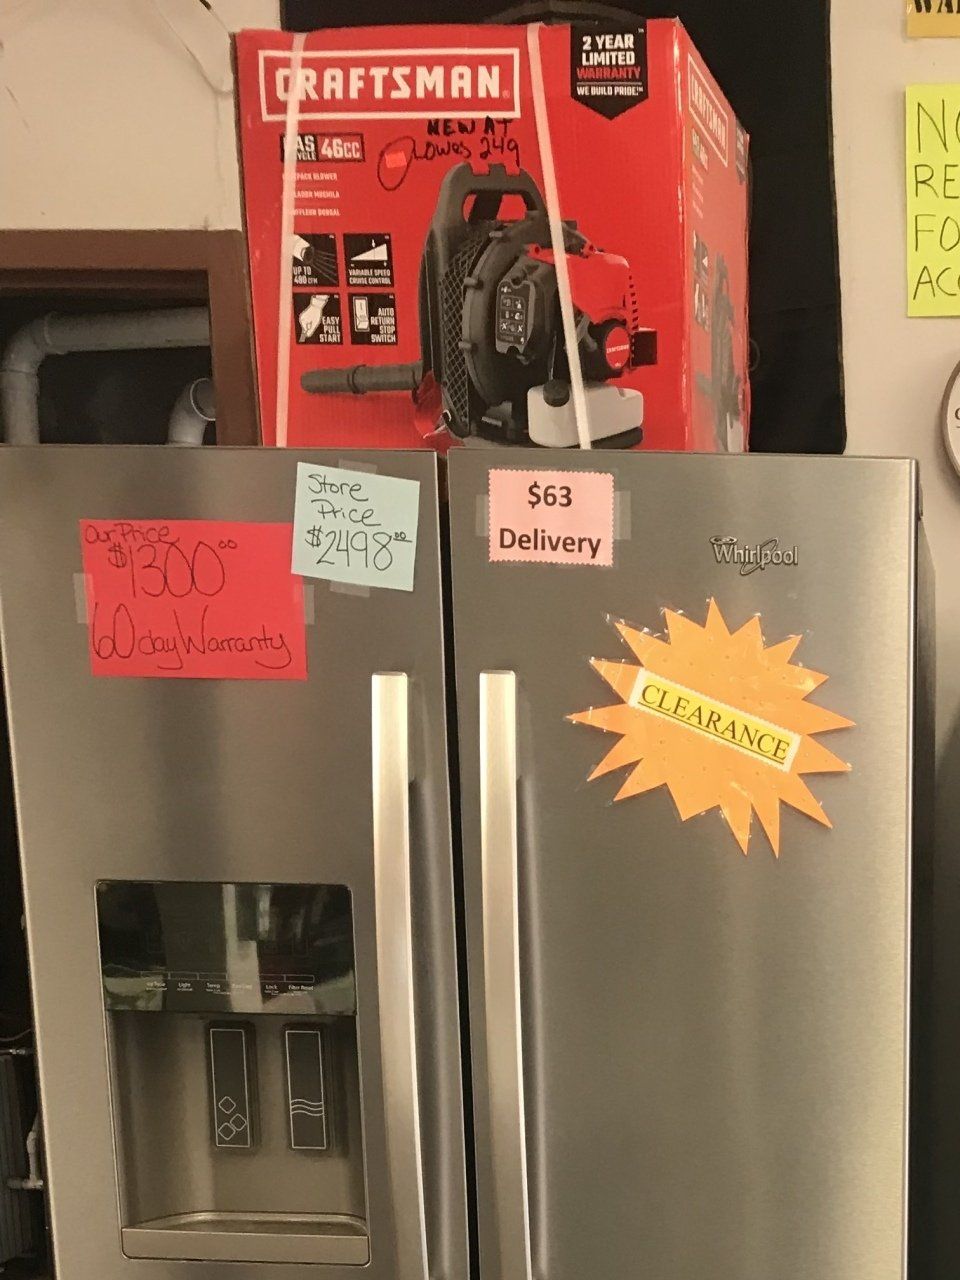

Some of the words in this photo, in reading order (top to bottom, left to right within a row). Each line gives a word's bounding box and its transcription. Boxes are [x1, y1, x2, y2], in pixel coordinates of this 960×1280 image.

[582, 35, 592, 50] 2
[595, 33, 634, 50] YEAR
[581, 51, 636, 66] LIMITED
[577, 66, 641, 79] WARRANTY
[275, 65, 501, 101] CRAFTSMAN
[577, 86, 590, 96] WE
[591, 86, 613, 96] BUILD
[427, 119, 475, 135] NEW
[484, 116, 513, 135] AT
[283, 135, 315, 152] AS
[480, 137, 520, 167] 249
[293, 266, 302, 275] UP
[303, 266, 311, 275] TO
[349, 277, 367, 285] CRUISE
[368, 277, 391, 285] CONTROL
[378, 308, 394, 316] AUTO
[322, 317, 339, 325] EASY
[324, 325, 340, 334] PULL
[370, 317, 395, 325] RETURN
[379, 325, 395, 334] STOP
[319, 334, 341, 343] START
[370, 334, 396, 343] SWITCH
[308, 474, 369, 502] Store
[528, 481, 572, 508] $63
[311, 500, 381, 527] Price
[112, 523, 180, 545] Price
[499, 528, 601, 559] Delivery
[711, 541, 798, 573] Whirlpool
[93, 603, 135, 659] 60
[640, 684, 790, 762] CLEARANCE
